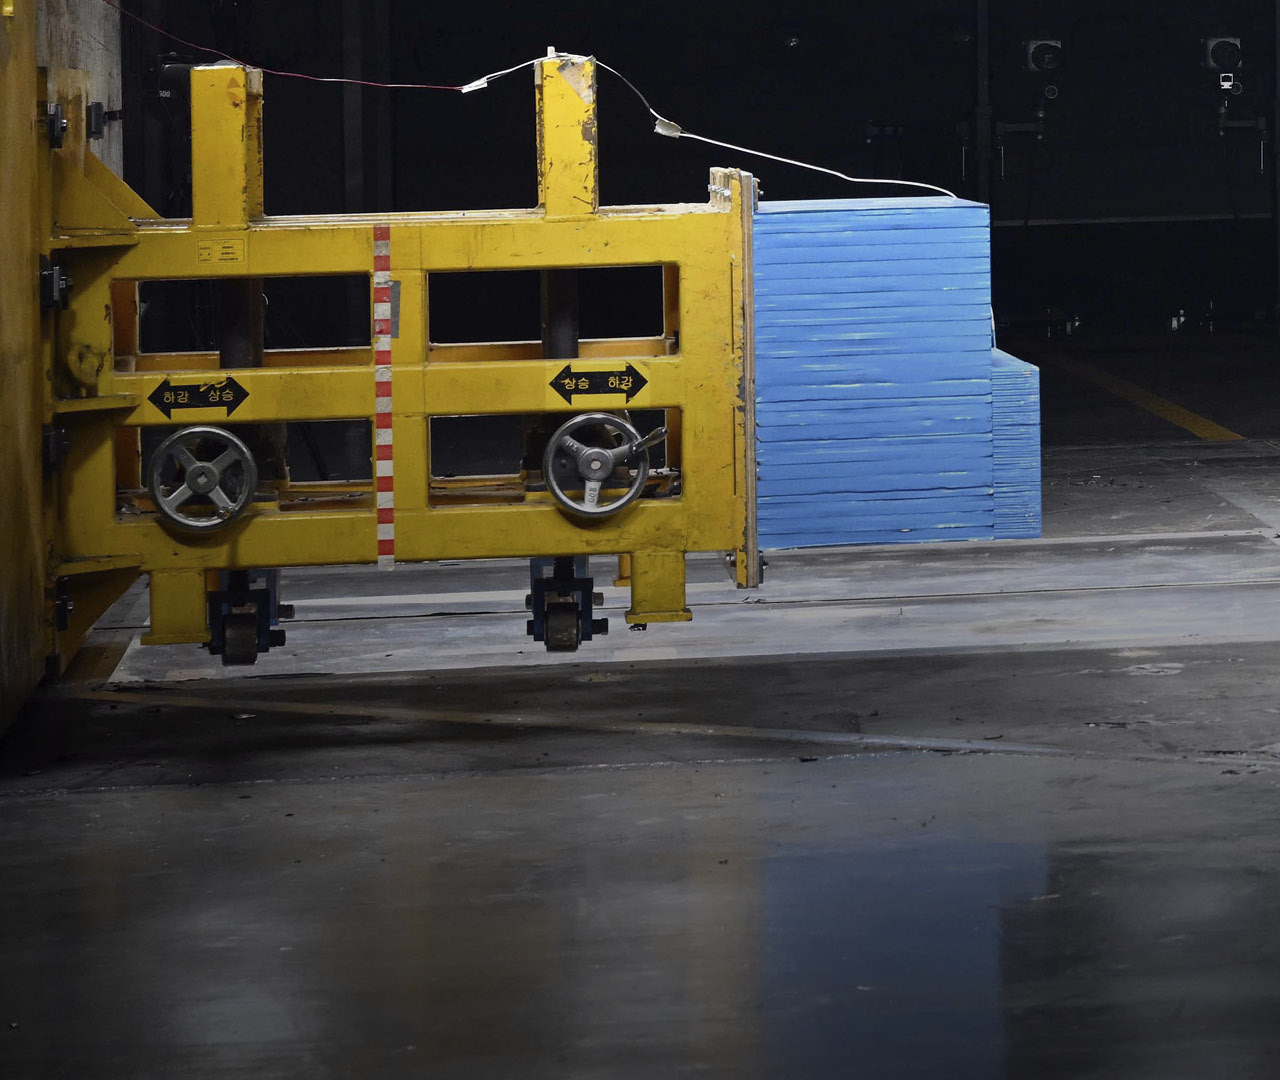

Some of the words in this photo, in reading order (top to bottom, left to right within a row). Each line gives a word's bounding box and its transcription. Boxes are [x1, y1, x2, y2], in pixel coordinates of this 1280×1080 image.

[560, 377, 590, 390] 상승
[607, 375, 634, 391] 하강
[163, 390, 190, 404] 하강
[208, 388, 234, 402] 상승
